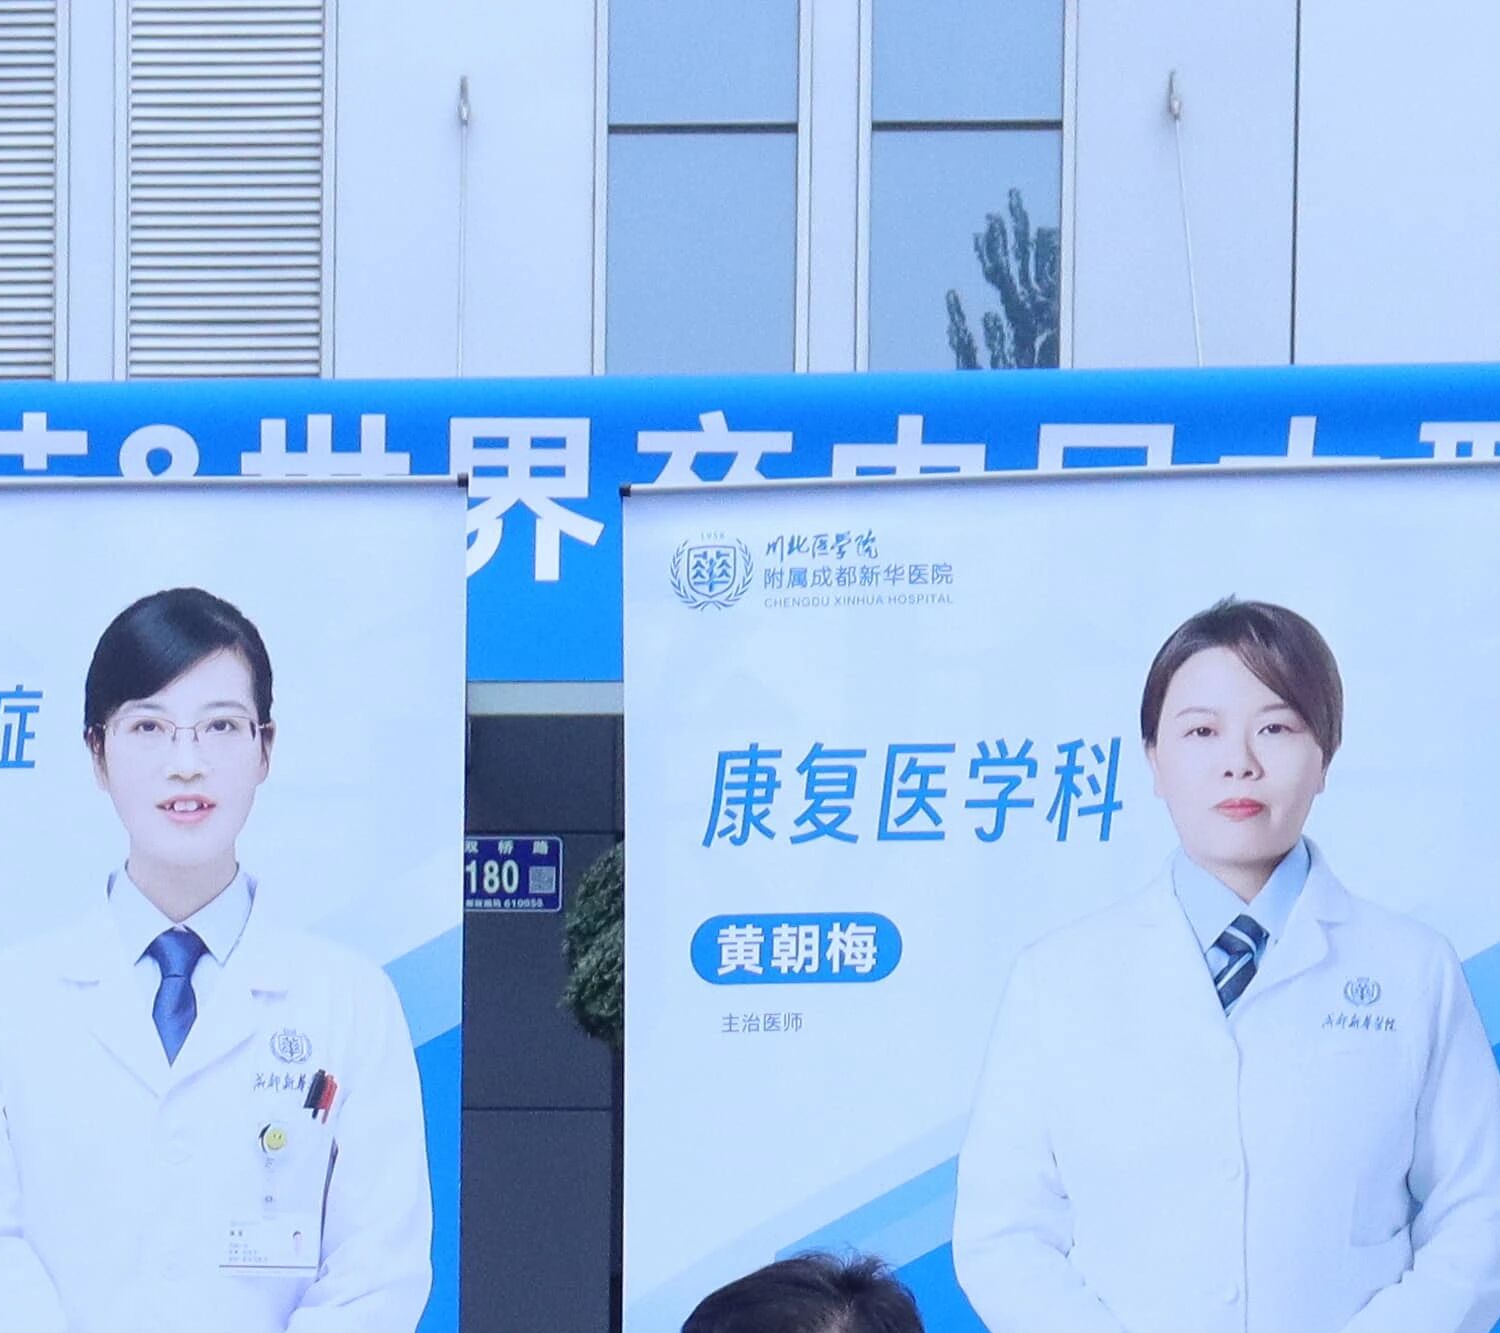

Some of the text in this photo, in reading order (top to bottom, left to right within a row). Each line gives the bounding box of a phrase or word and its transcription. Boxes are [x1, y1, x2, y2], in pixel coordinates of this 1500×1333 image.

[764, 562, 953, 590] 附属成都新华医院
[702, 737, 1125, 848] 康复医学科
[466, 859, 519, 894] 180
[714, 921, 877, 976] 黄朝梅
[721, 1010, 803, 1034] 主治医师
